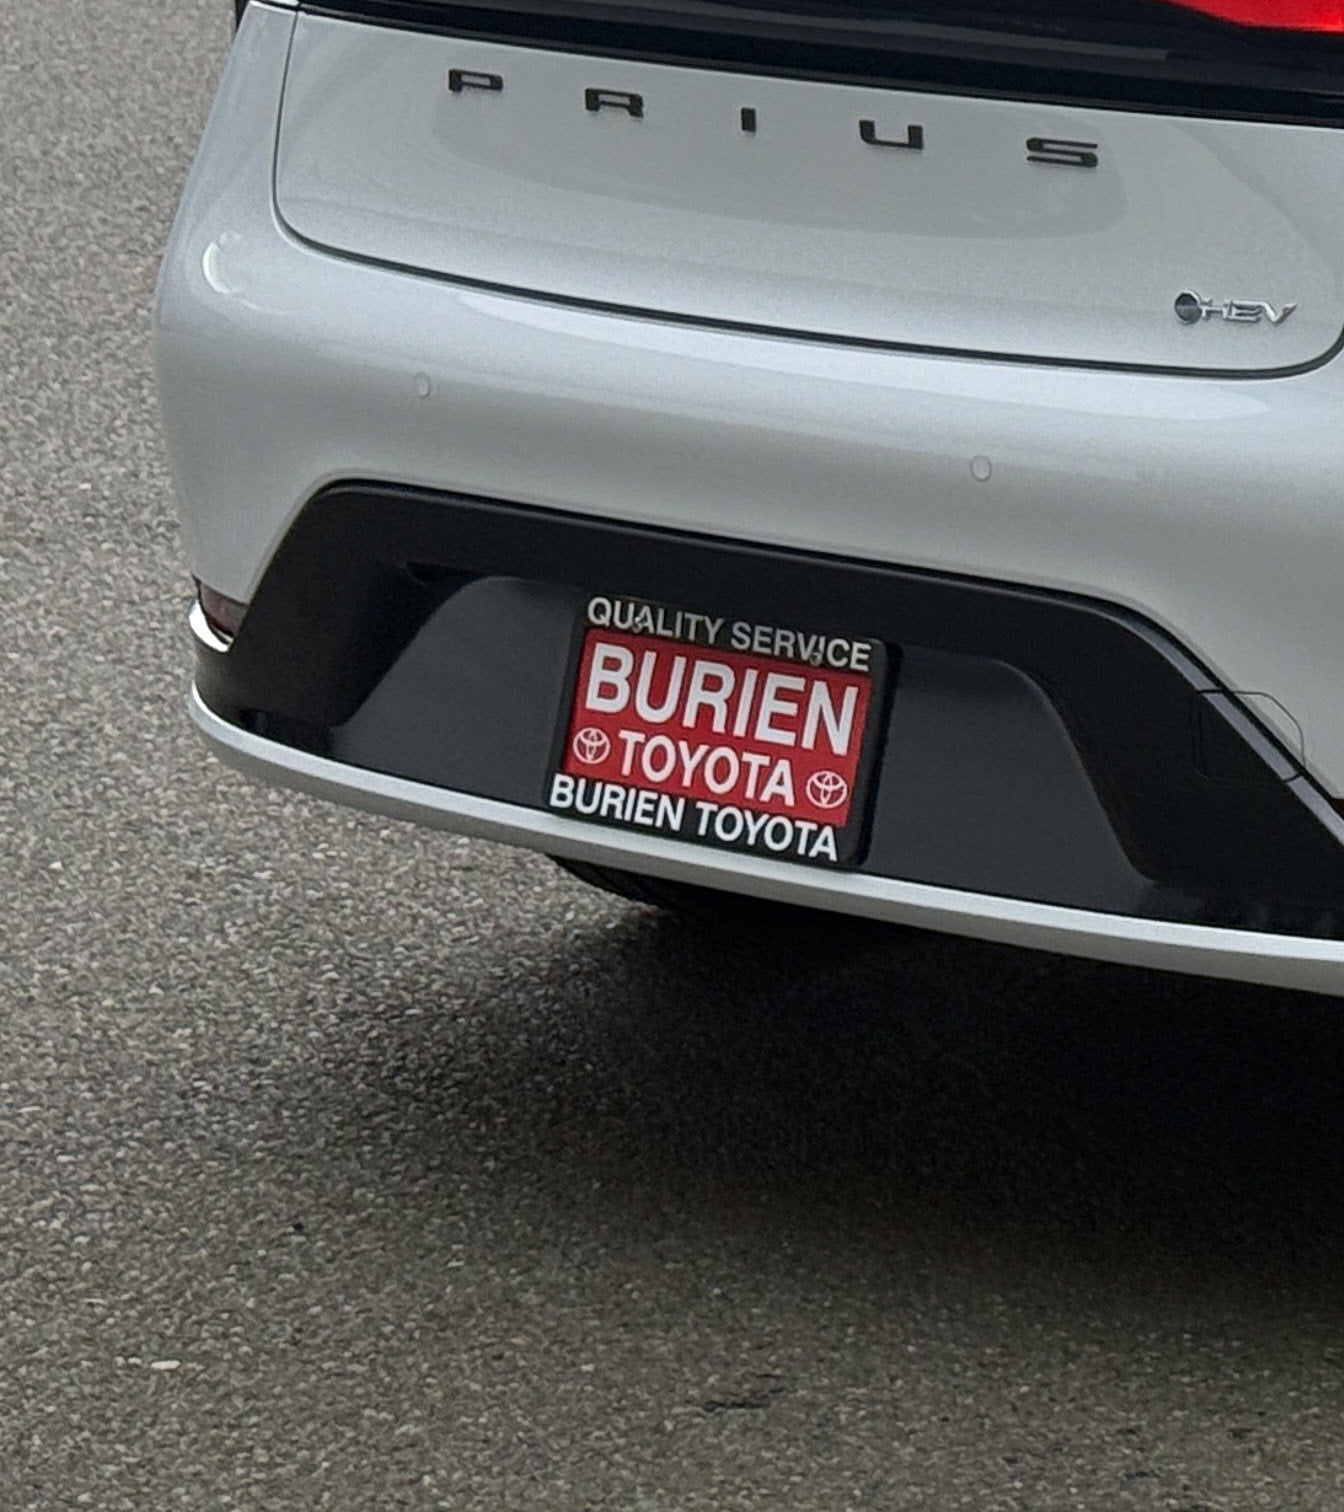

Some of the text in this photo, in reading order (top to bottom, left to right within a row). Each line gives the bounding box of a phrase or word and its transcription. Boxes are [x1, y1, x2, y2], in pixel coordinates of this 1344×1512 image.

[447, 67, 1099, 169] PRIUS
[586, 596, 873, 672] QUALITY SERVICE
[584, 642, 860, 757] BURIEN
[618, 729, 796, 807] TOYOTA
[549, 773, 839, 863] BURIEN TOYOTA
